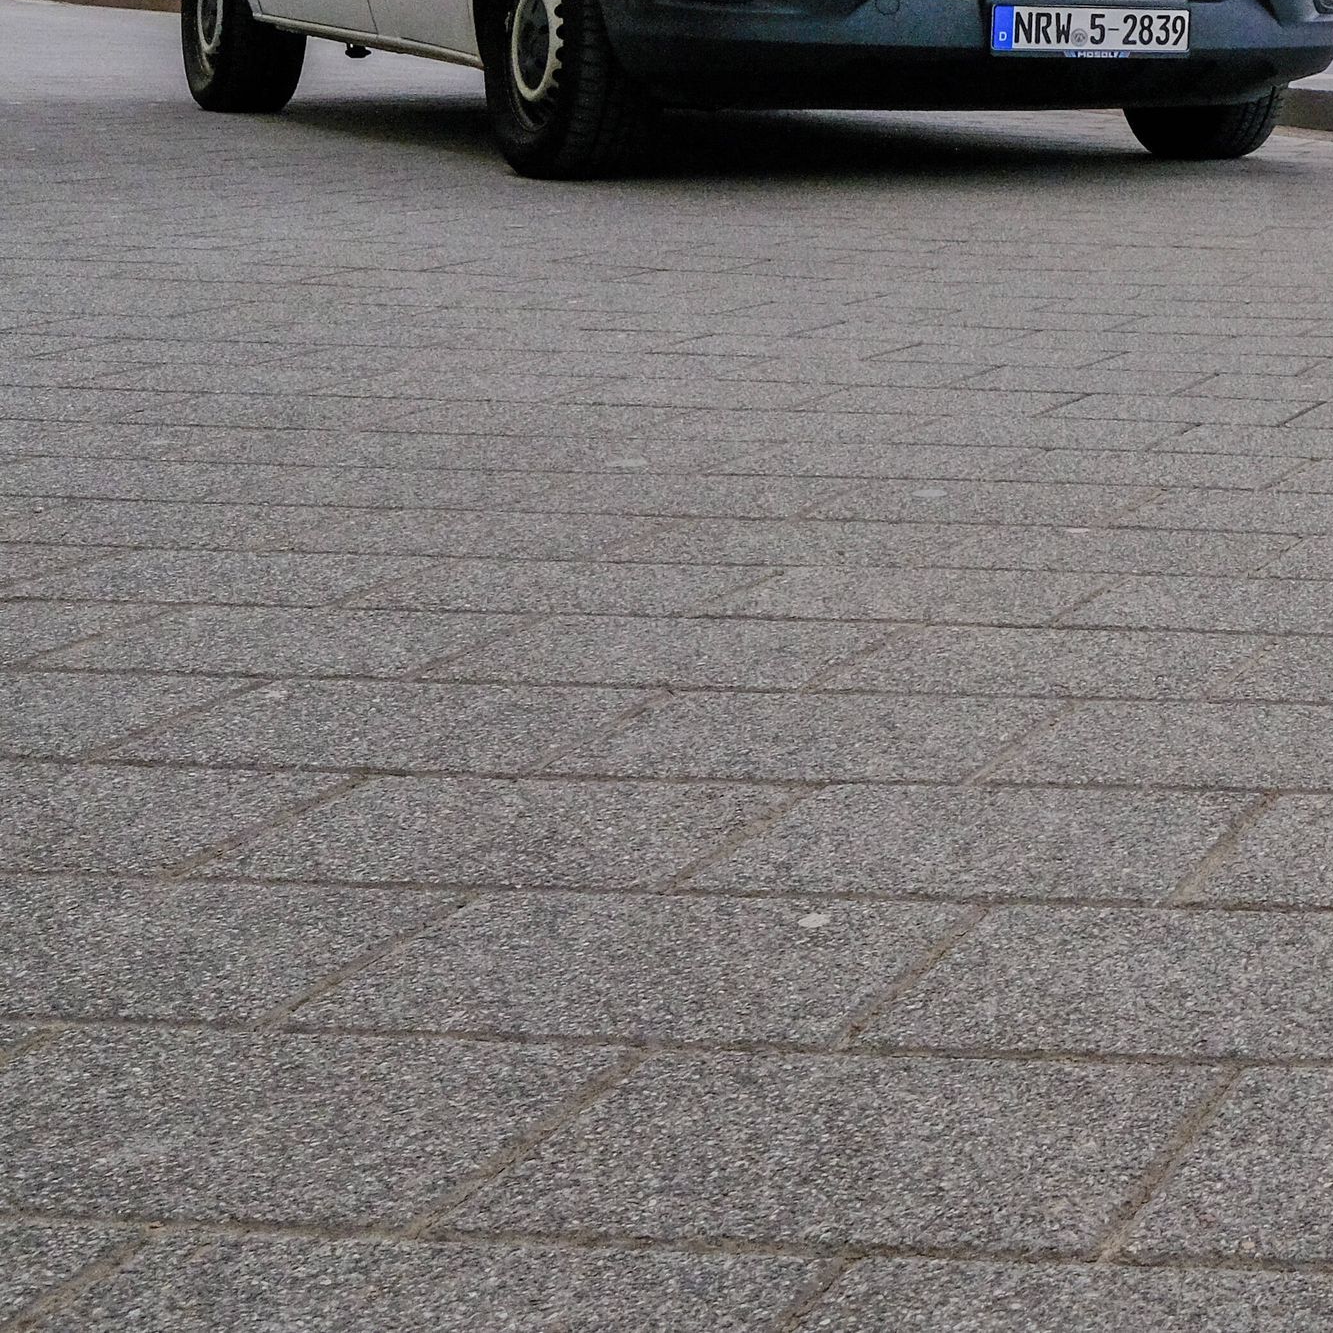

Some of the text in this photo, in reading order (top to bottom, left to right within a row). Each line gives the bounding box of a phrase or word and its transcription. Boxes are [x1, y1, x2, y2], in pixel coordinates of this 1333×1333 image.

[999, 11, 1186, 46] D NRW 5-2839
